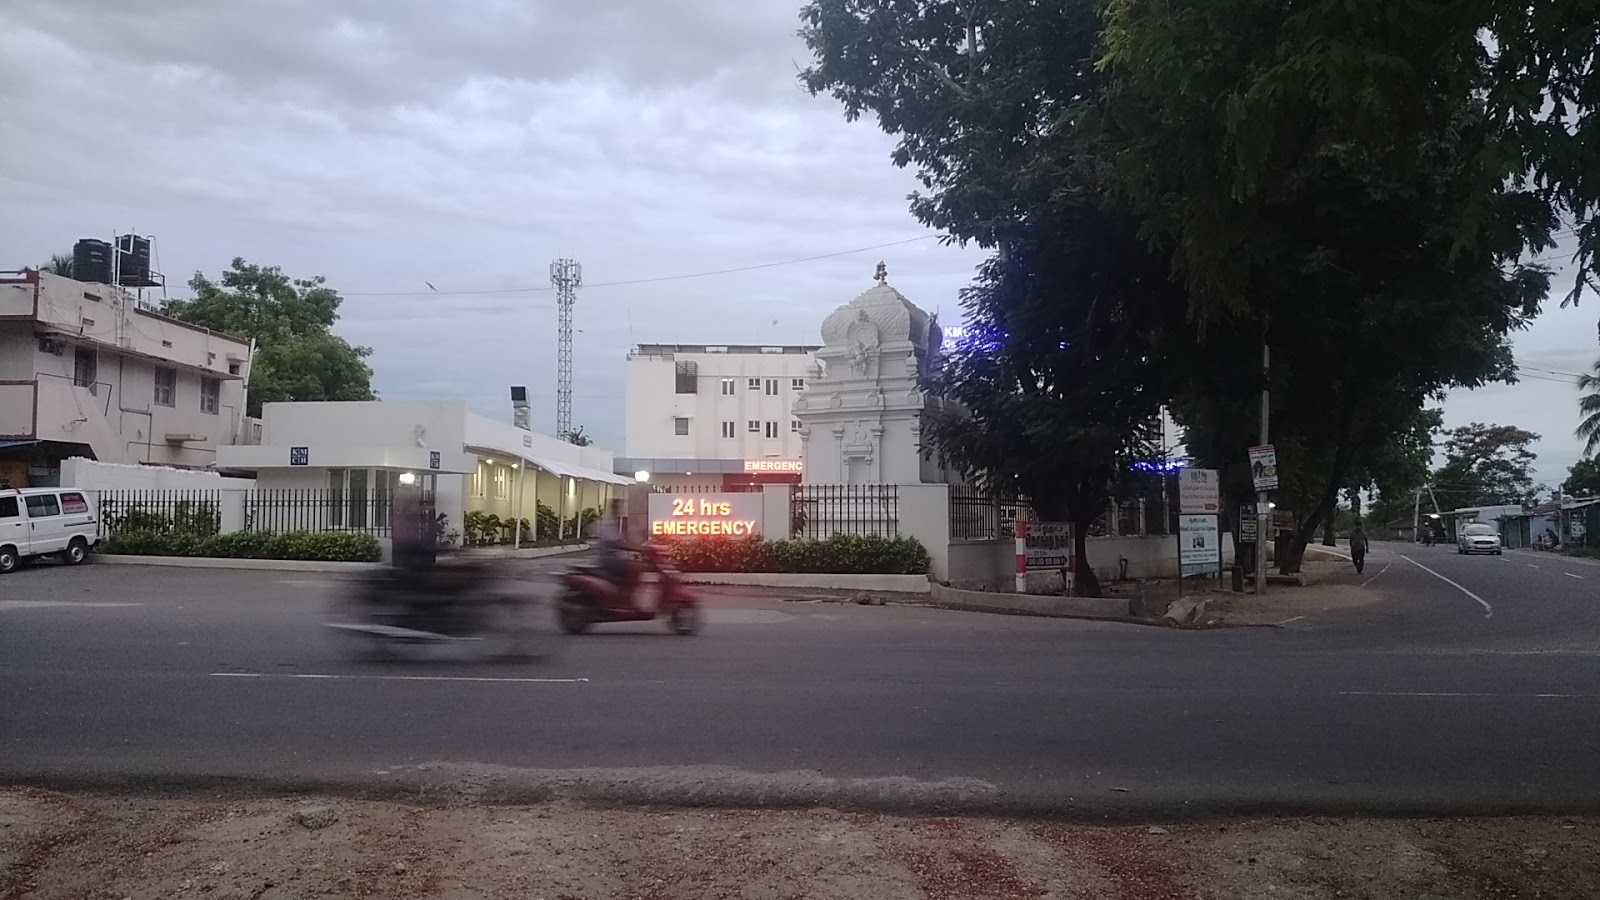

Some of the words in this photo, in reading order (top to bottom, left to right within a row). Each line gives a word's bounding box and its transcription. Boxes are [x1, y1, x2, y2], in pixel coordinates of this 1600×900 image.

[744, 461, 803, 471] EMERGENC
[672, 499, 695, 516] 24
[700, 499, 731, 516] hrs
[652, 520, 756, 535] EMERGENCY
